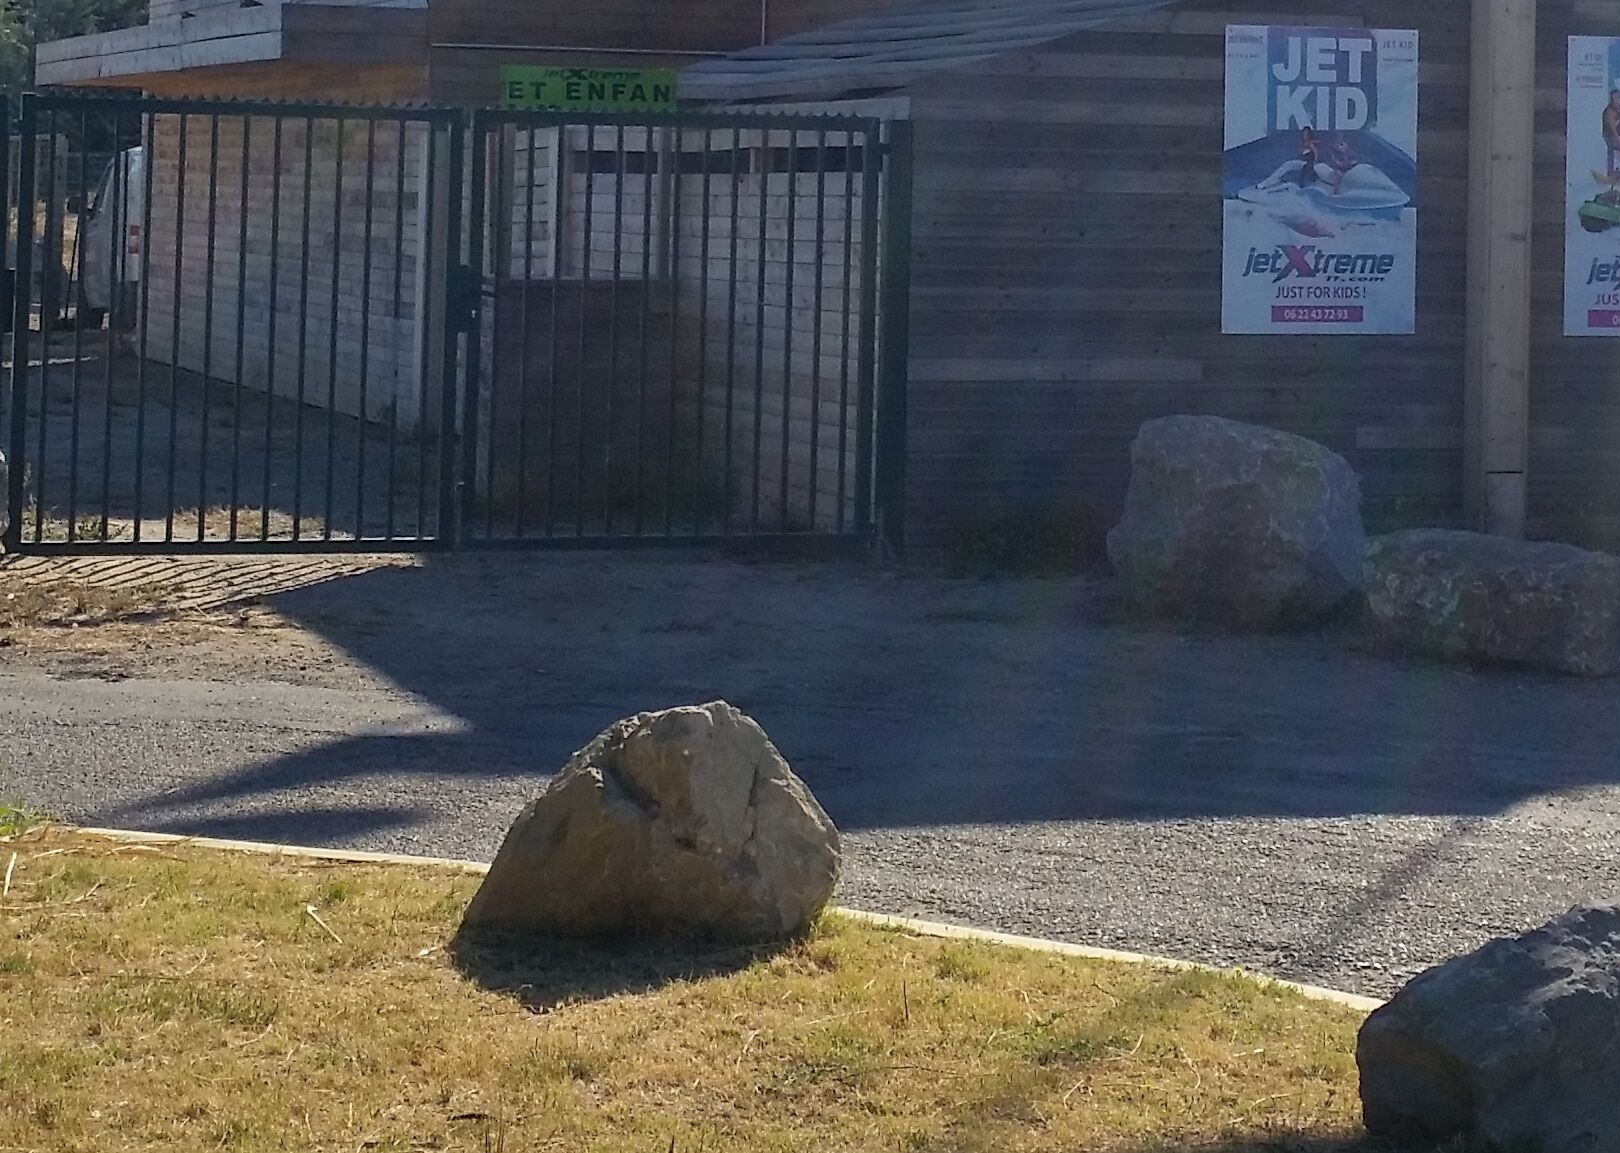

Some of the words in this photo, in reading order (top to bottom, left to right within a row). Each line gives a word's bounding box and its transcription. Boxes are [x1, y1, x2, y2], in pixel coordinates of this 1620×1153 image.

[1272, 36, 1372, 83] JET
[508, 81, 547, 100] ET
[1276, 85, 1368, 131] KID
[1242, 244, 1394, 284] jetXtreme
[1275, 286, 1304, 299] JUST
[1307, 286, 1331, 299] FOR
[1324, 309, 1335, 320] 72
